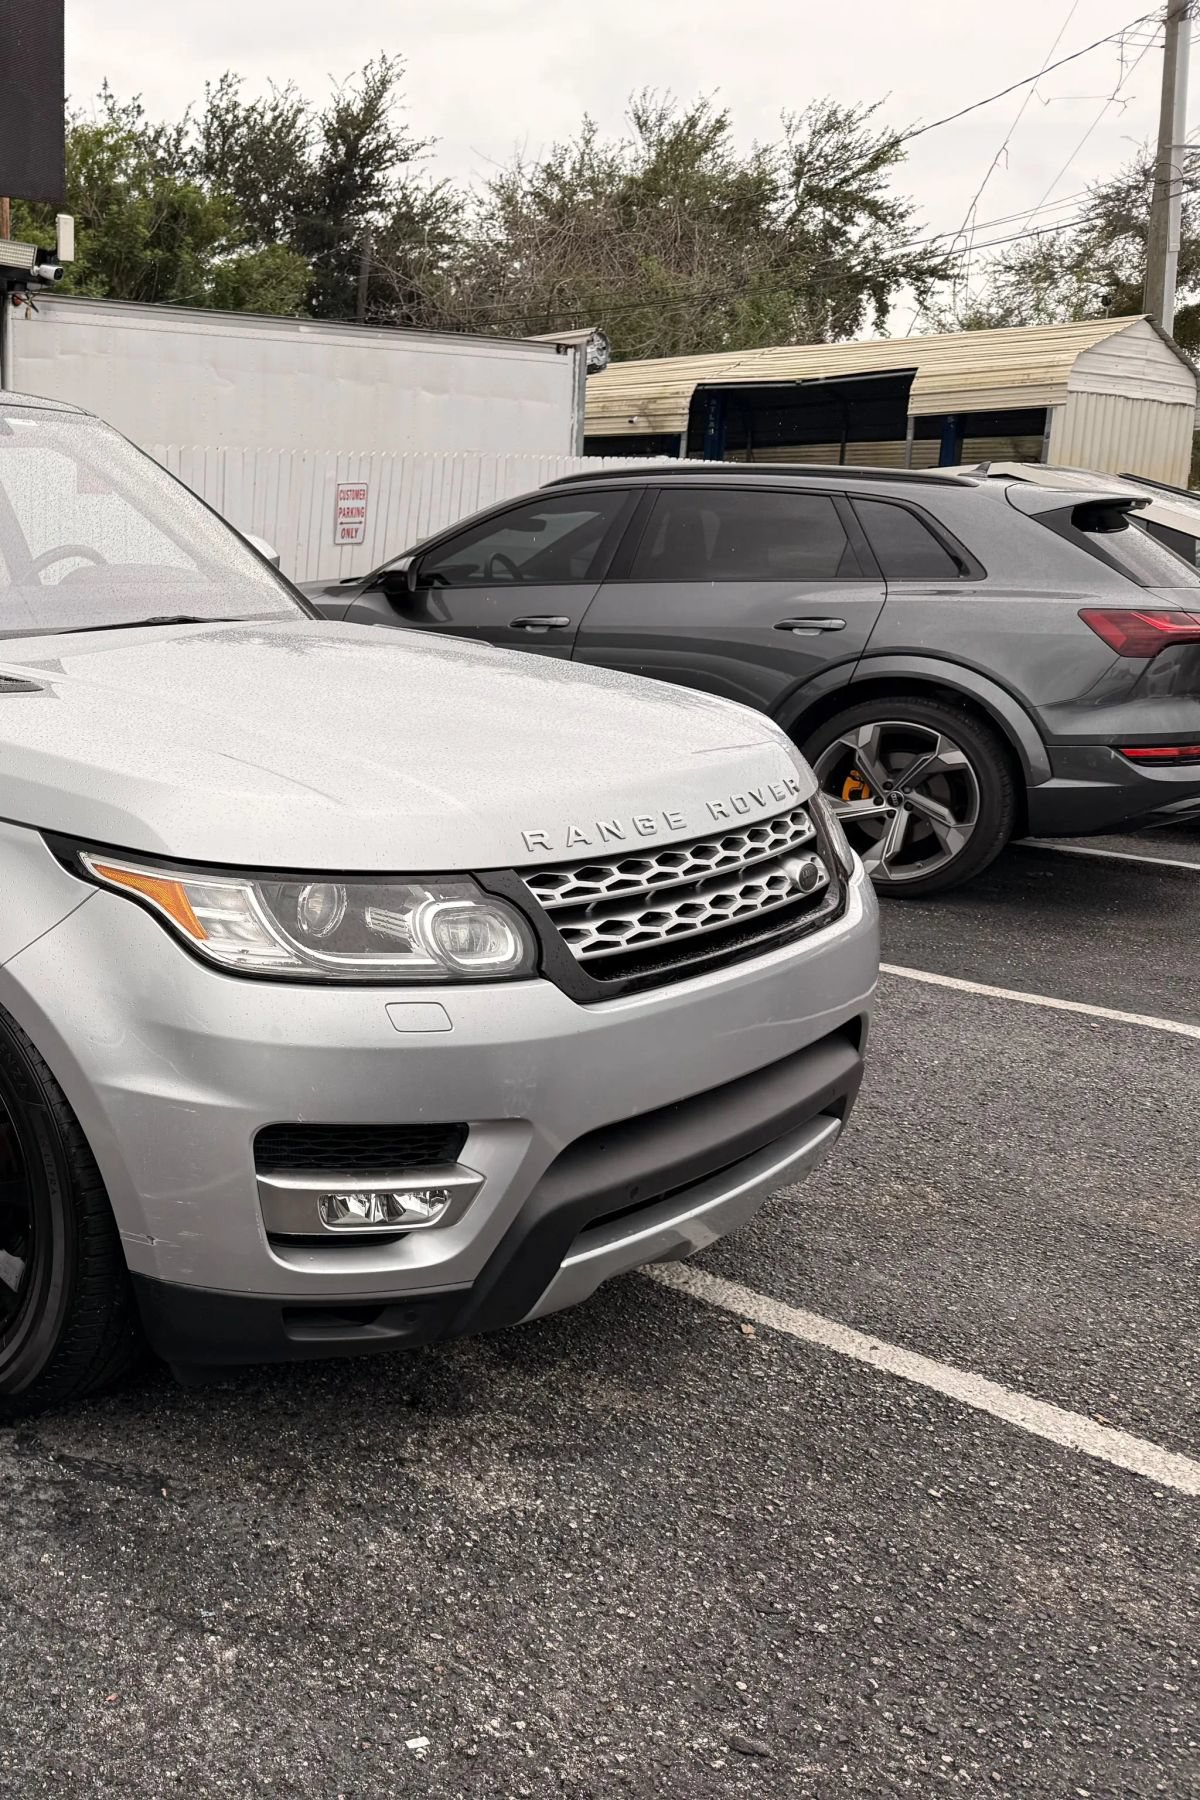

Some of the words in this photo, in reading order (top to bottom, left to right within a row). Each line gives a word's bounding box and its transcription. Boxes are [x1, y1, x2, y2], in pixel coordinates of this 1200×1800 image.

[339, 489, 366, 501] CUSTOMER
[338, 507, 364, 518] PARKING
[341, 528, 359, 539] ONLY
[520, 810, 688, 852] RANGE
[705, 777, 802, 821] ROVER
